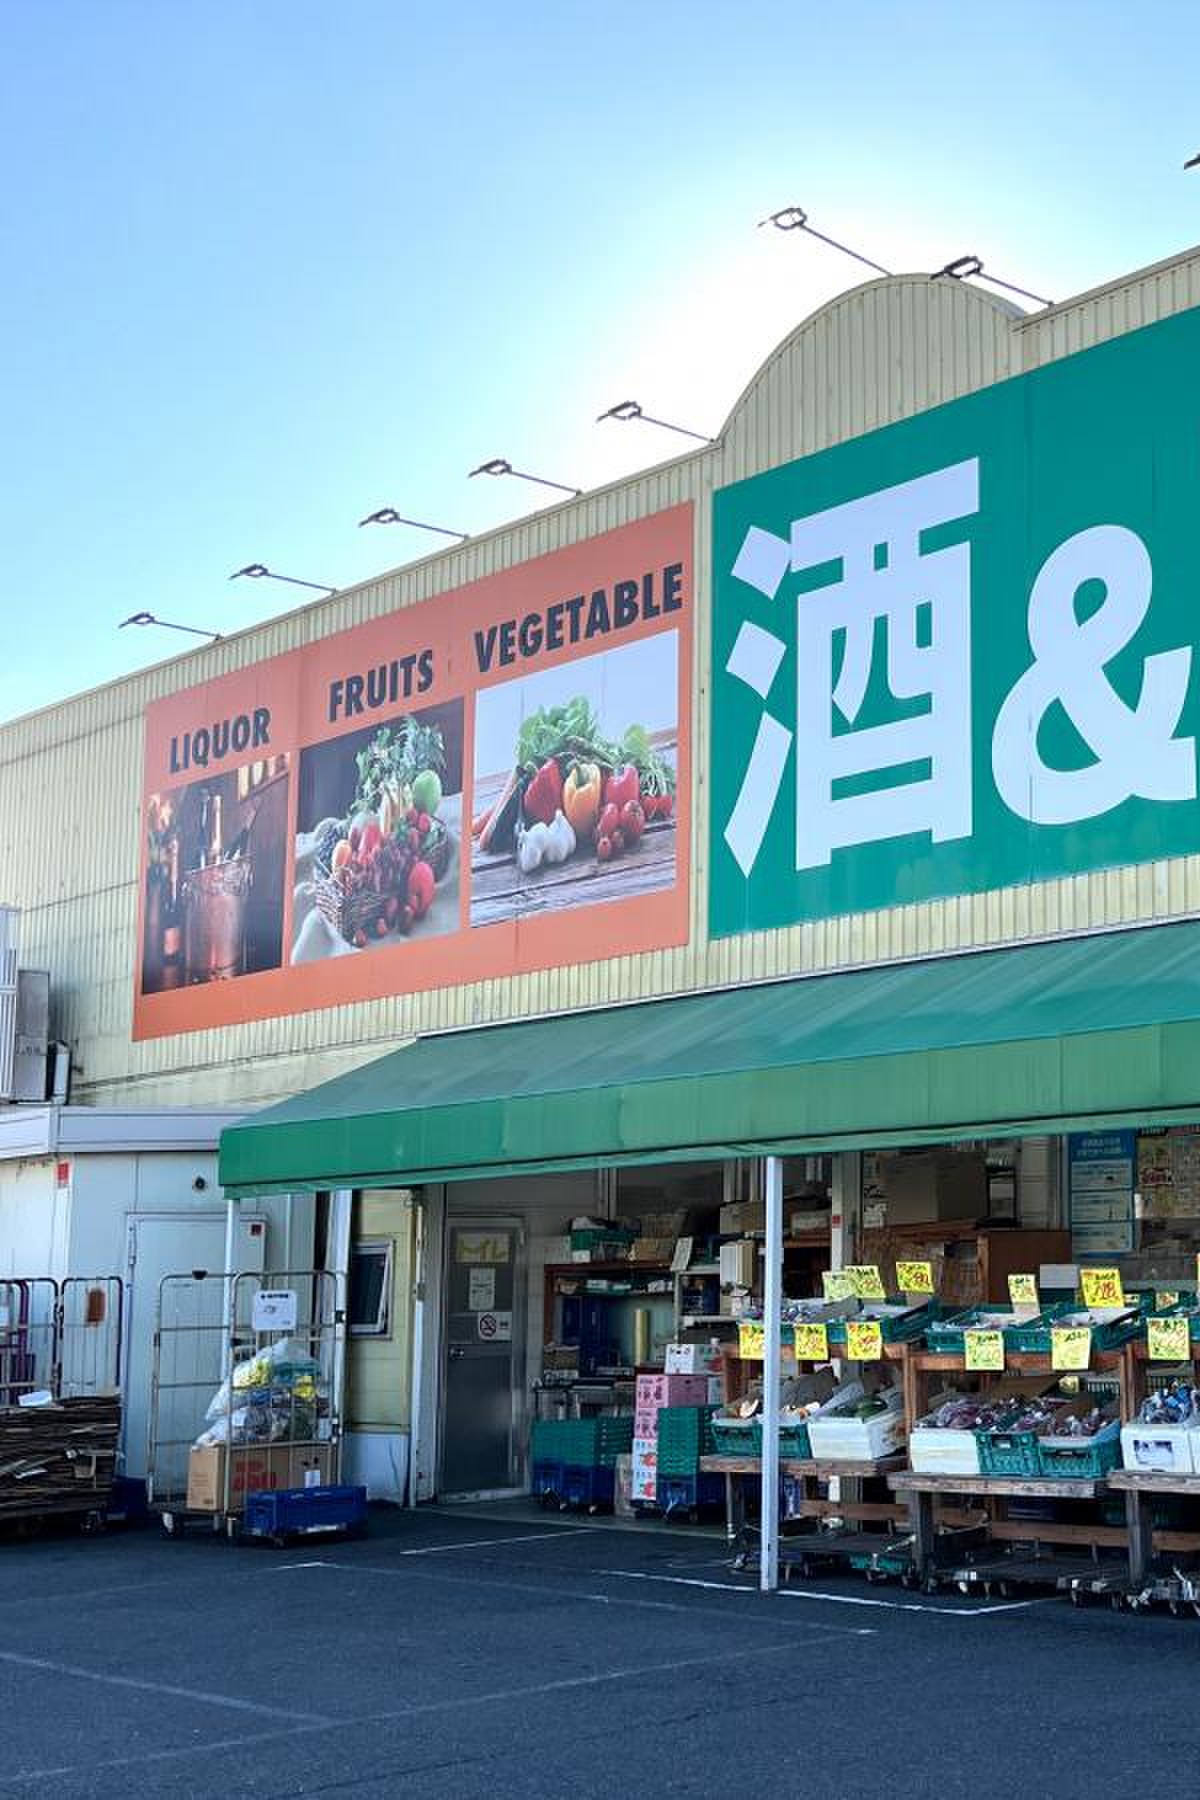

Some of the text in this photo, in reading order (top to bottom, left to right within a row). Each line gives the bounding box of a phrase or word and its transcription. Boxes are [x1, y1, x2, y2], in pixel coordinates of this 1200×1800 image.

[473, 563, 684, 674] VEGETABLE
[329, 649, 434, 722] FRUITS
[169, 707, 270, 773] LIQUOR
